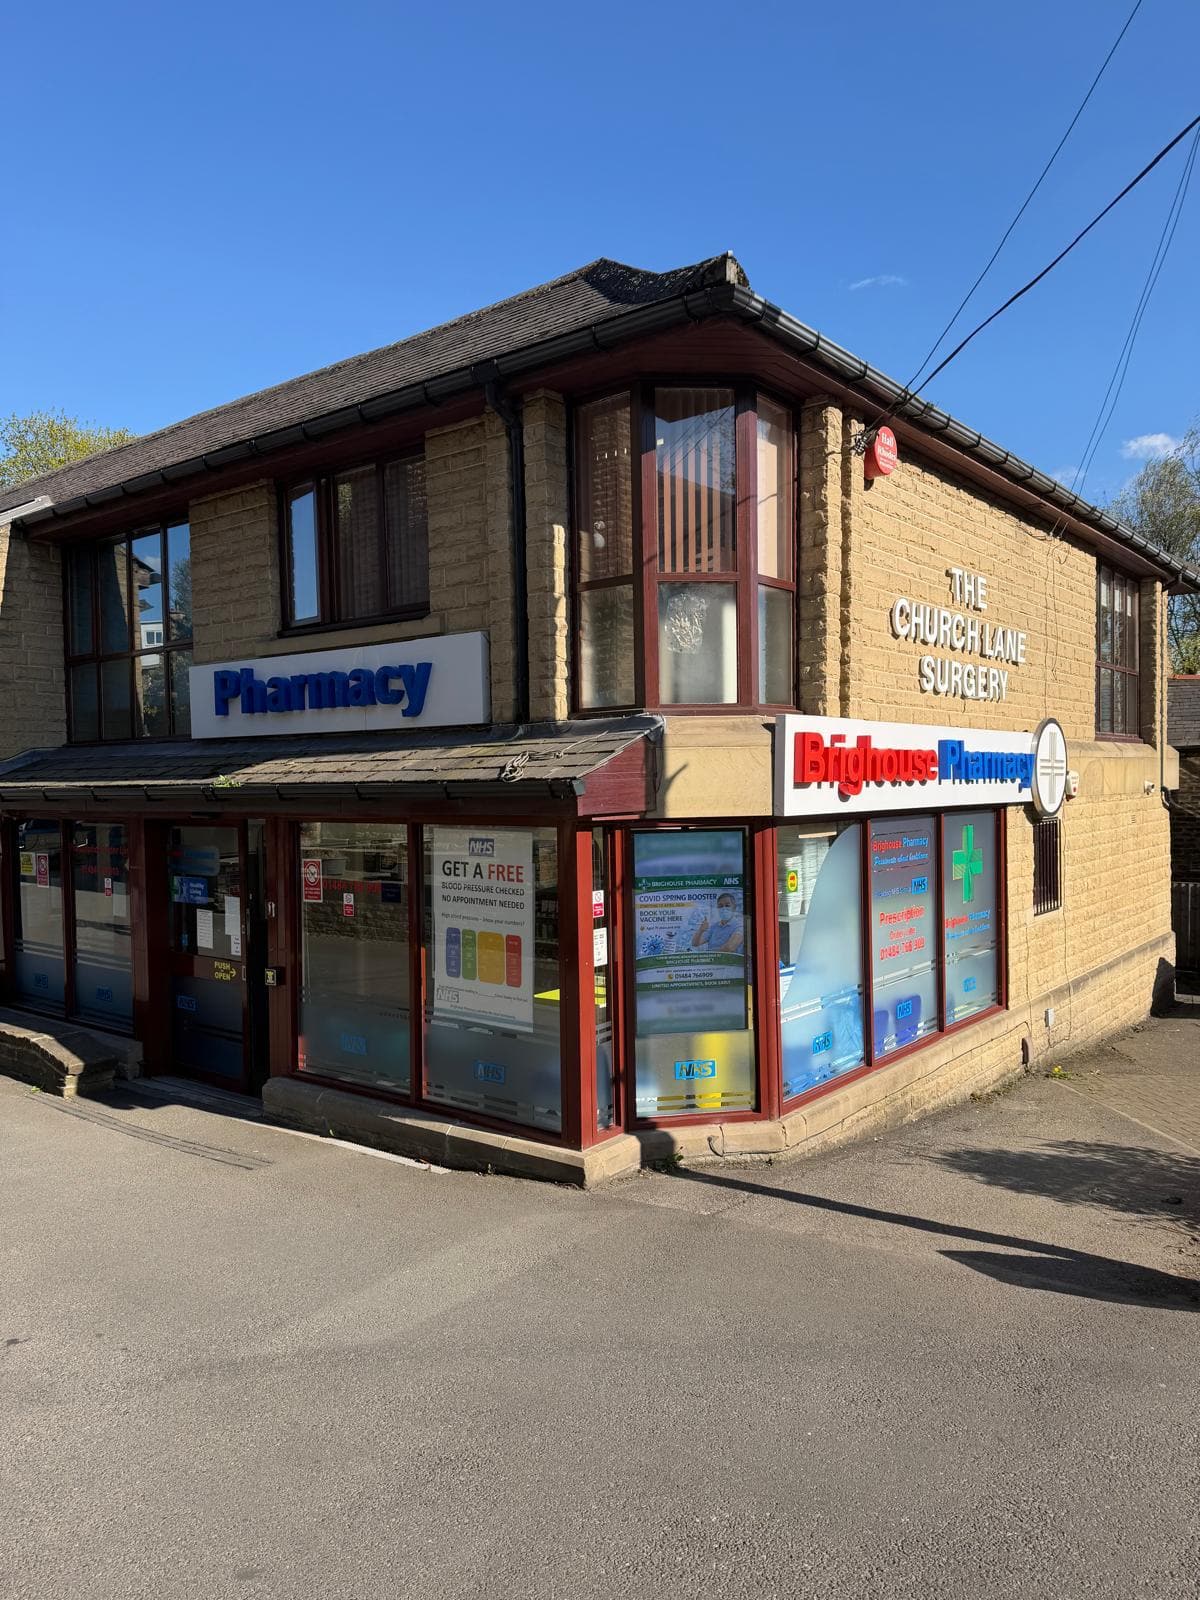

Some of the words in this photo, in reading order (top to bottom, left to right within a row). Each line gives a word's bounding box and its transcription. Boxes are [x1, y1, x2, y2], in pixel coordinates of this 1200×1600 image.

[949, 567, 988, 610] THE
[892, 598, 981, 653] CHURCH
[982, 623, 1027, 664] LANE
[920, 655, 1009, 701] SURGERY
[214, 663, 432, 717] Pharmacy
[793, 731, 938, 796] Brighouse
[938, 739, 1035, 789] Pharmacy
[469, 839, 494, 855] NHS
[872, 839, 901, 853] Brighouse
[902, 836, 929, 848] Pharmacy
[442, 860, 469, 878] GET
[473, 862, 484, 879] A
[487, 863, 524, 883] FREE
[441, 881, 463, 891] BLOOD
[463, 884, 494, 894] PRESSURE
[495, 886, 525, 897] CHECKED
[651, 879, 683, 888] BRIGHOUSE
[685, 878, 718, 887] PHARMACY
[723, 877, 740, 885] NHS
[913, 878, 927, 893] NHS
[442, 894, 451, 903] NO
[452, 896, 498, 908] APPOINTMENT
[499, 899, 525, 910] NEEDED
[639, 895, 661, 903] COVID
[662, 894, 687, 902] SPRING
[687, 893, 718, 901] BOOSTER
[639, 910, 658, 918] BOOK
[659, 909, 676, 917] YOUR
[639, 916, 666, 924] VACCINE
[667, 915, 684, 923] HERE
[879, 905, 925, 927] Prescription
[214, 961, 231, 971] PUSH
[214, 971, 231, 982] OPEN
[437, 988, 460, 1004] NHS
[477, 1063, 504, 1083] NHS
[678, 1062, 714, 1078] NHS
